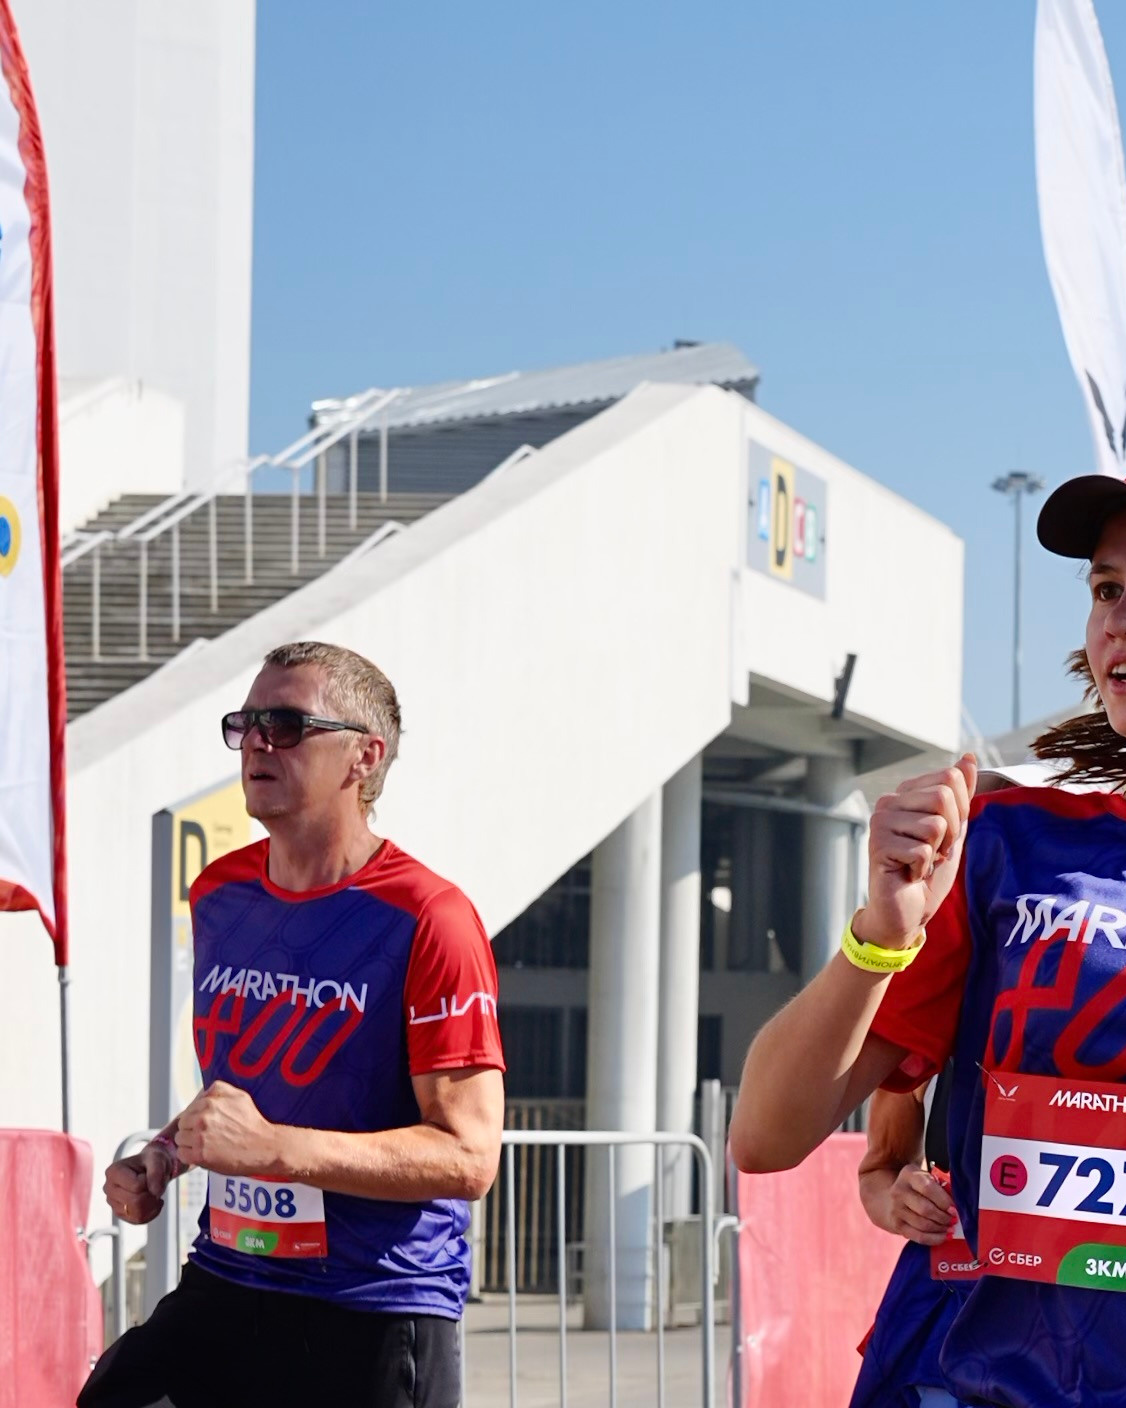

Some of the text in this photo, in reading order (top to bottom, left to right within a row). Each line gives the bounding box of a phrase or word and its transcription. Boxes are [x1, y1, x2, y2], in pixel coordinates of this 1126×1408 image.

[775, 473, 788, 568] D
[180, 820, 207, 902] D
[199, 964, 368, 1013] MARATHON
[999, 1161, 1018, 1188] E
[224, 1178, 297, 1219] 5508
[1007, 1252, 1042, 1267] СБЕР
